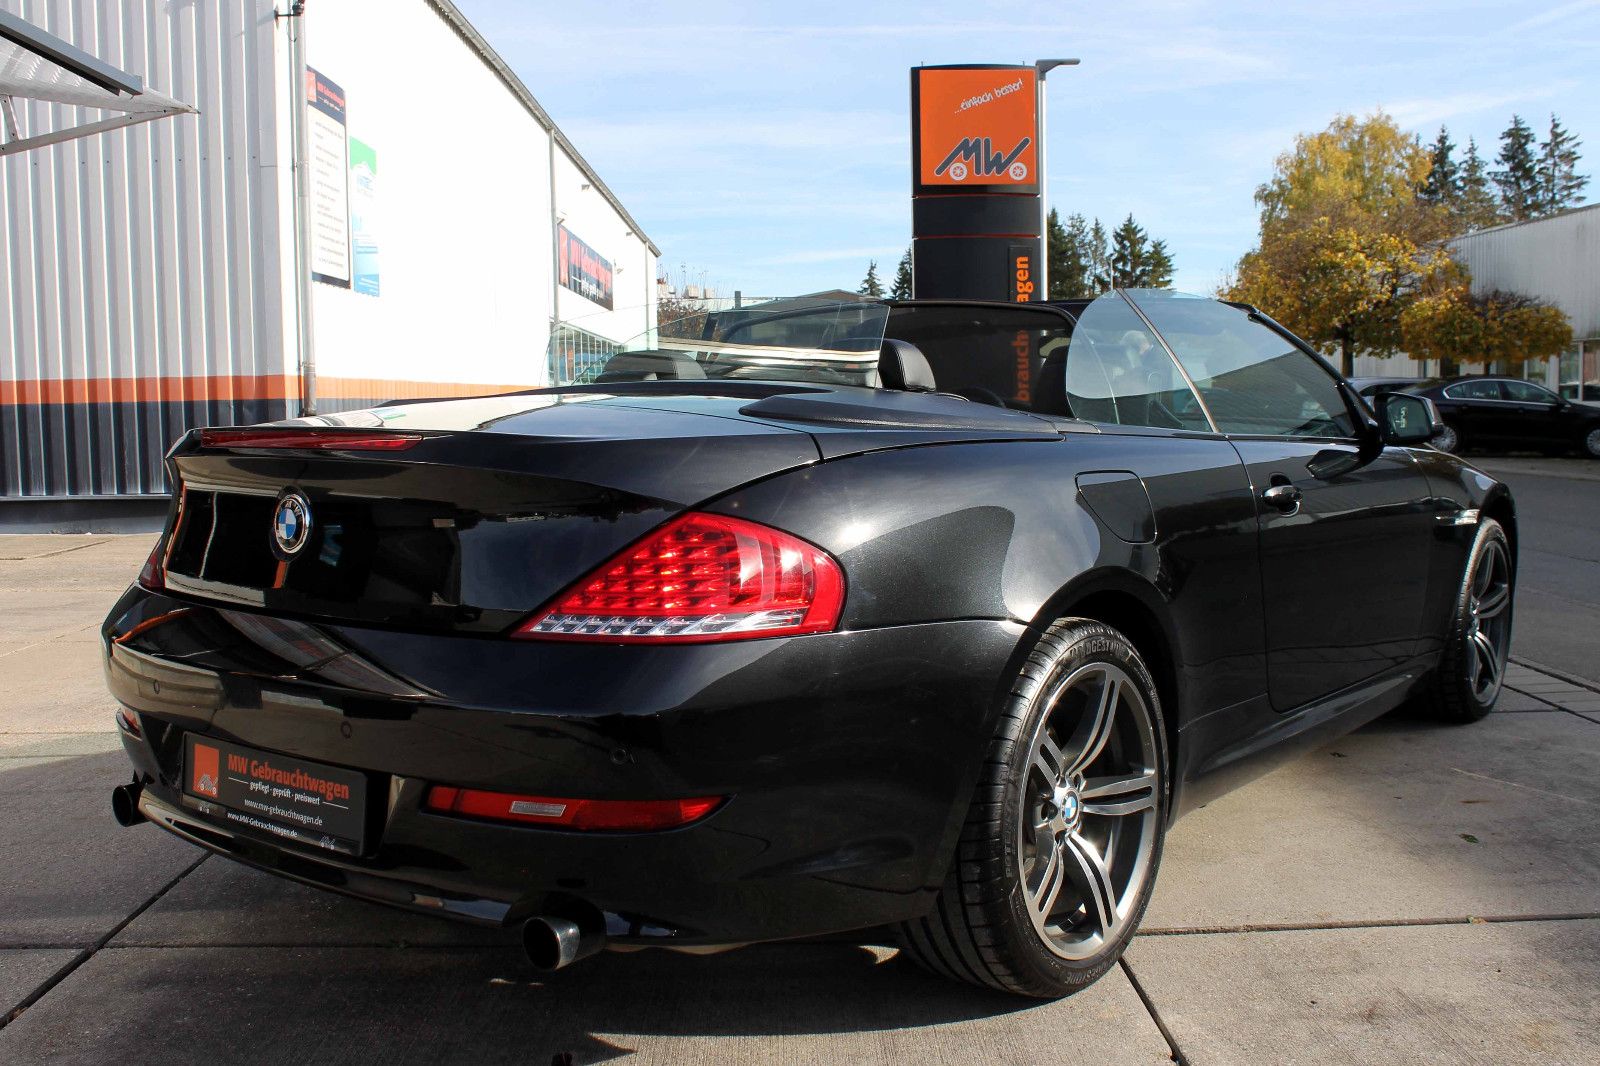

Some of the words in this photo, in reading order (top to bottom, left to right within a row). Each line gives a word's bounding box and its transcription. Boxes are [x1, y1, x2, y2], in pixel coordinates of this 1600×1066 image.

[934, 137, 1031, 176] MW
[227, 753, 249, 774] MW
[250, 760, 349, 801] Gebrauchtwagen
[272, 787, 291, 799] geprüft
[294, 792, 321, 806] preiswert
[227, 812, 298, 838] www.MW-Gebrauchtwagen.de
[244, 799, 323, 826] www.mw-gebrauchtwagen.de
